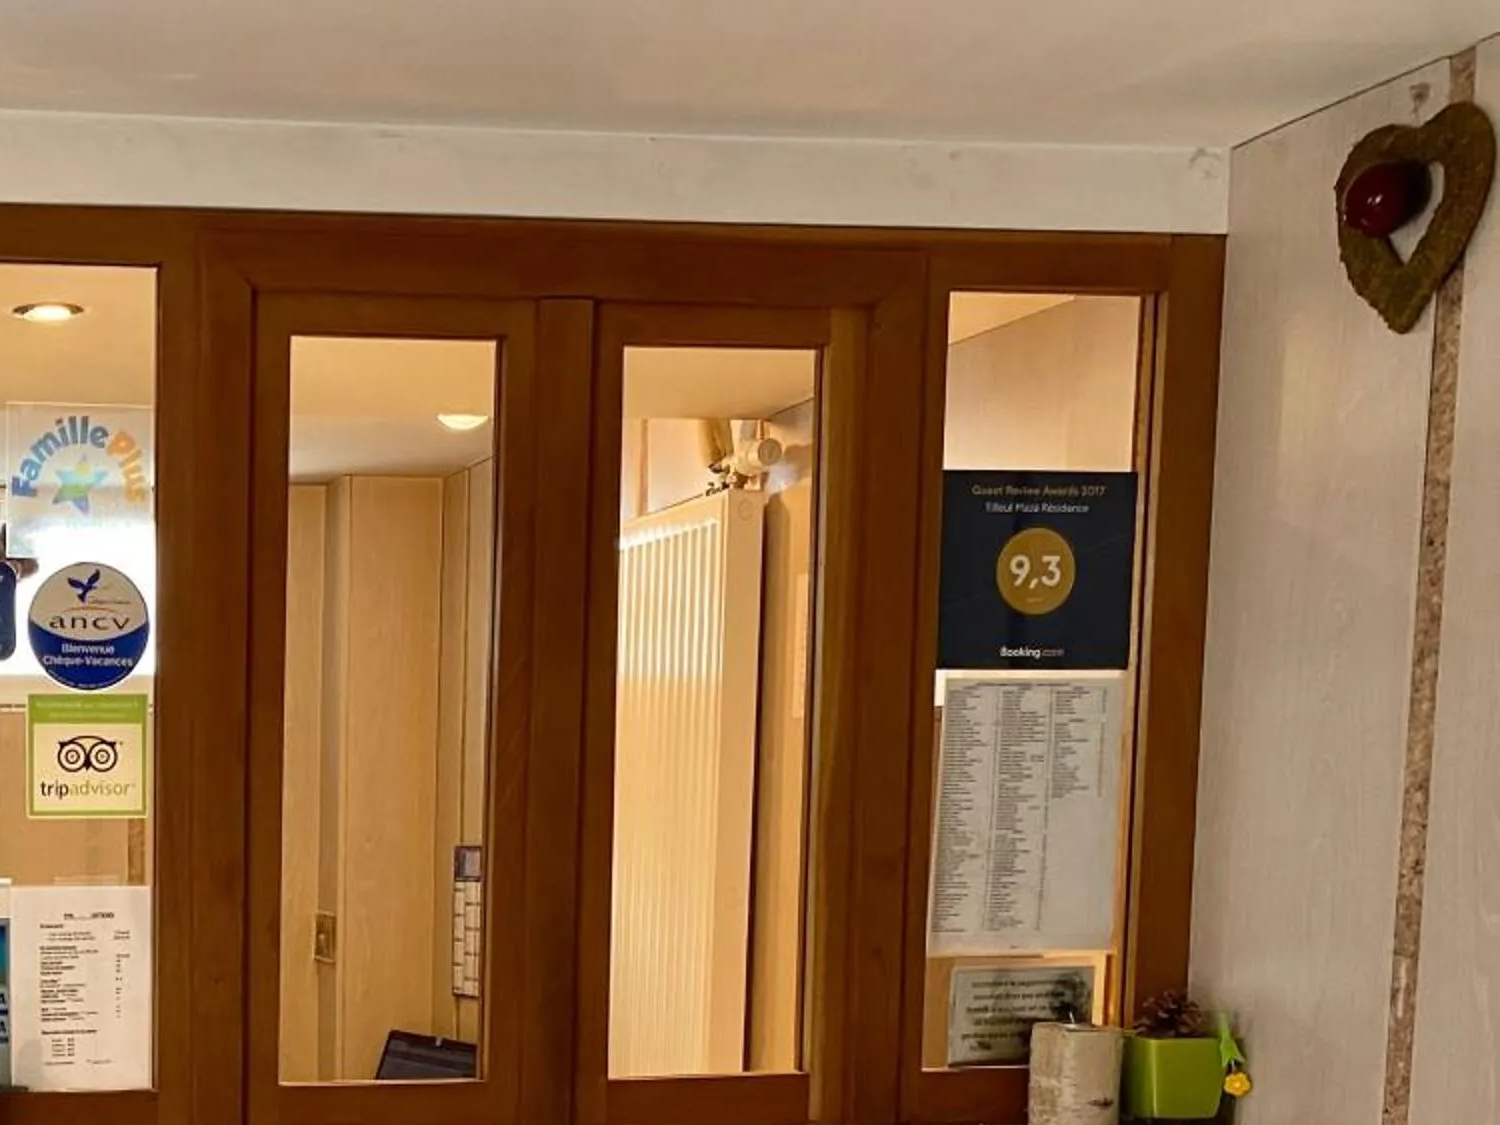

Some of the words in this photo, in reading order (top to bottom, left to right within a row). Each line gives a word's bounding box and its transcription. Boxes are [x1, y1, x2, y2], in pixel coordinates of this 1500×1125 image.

[11, 415, 109, 497] Famille
[972, 484, 1003, 496] Guest
[1043, 484, 1079, 497] Awards
[1081, 485, 1106, 497] 2017
[1009, 554, 1062, 590] 9,3
[48, 616, 131, 631] ancv
[61, 643, 115, 655] Bienvenue
[40, 780, 130, 800] tripadvisor
